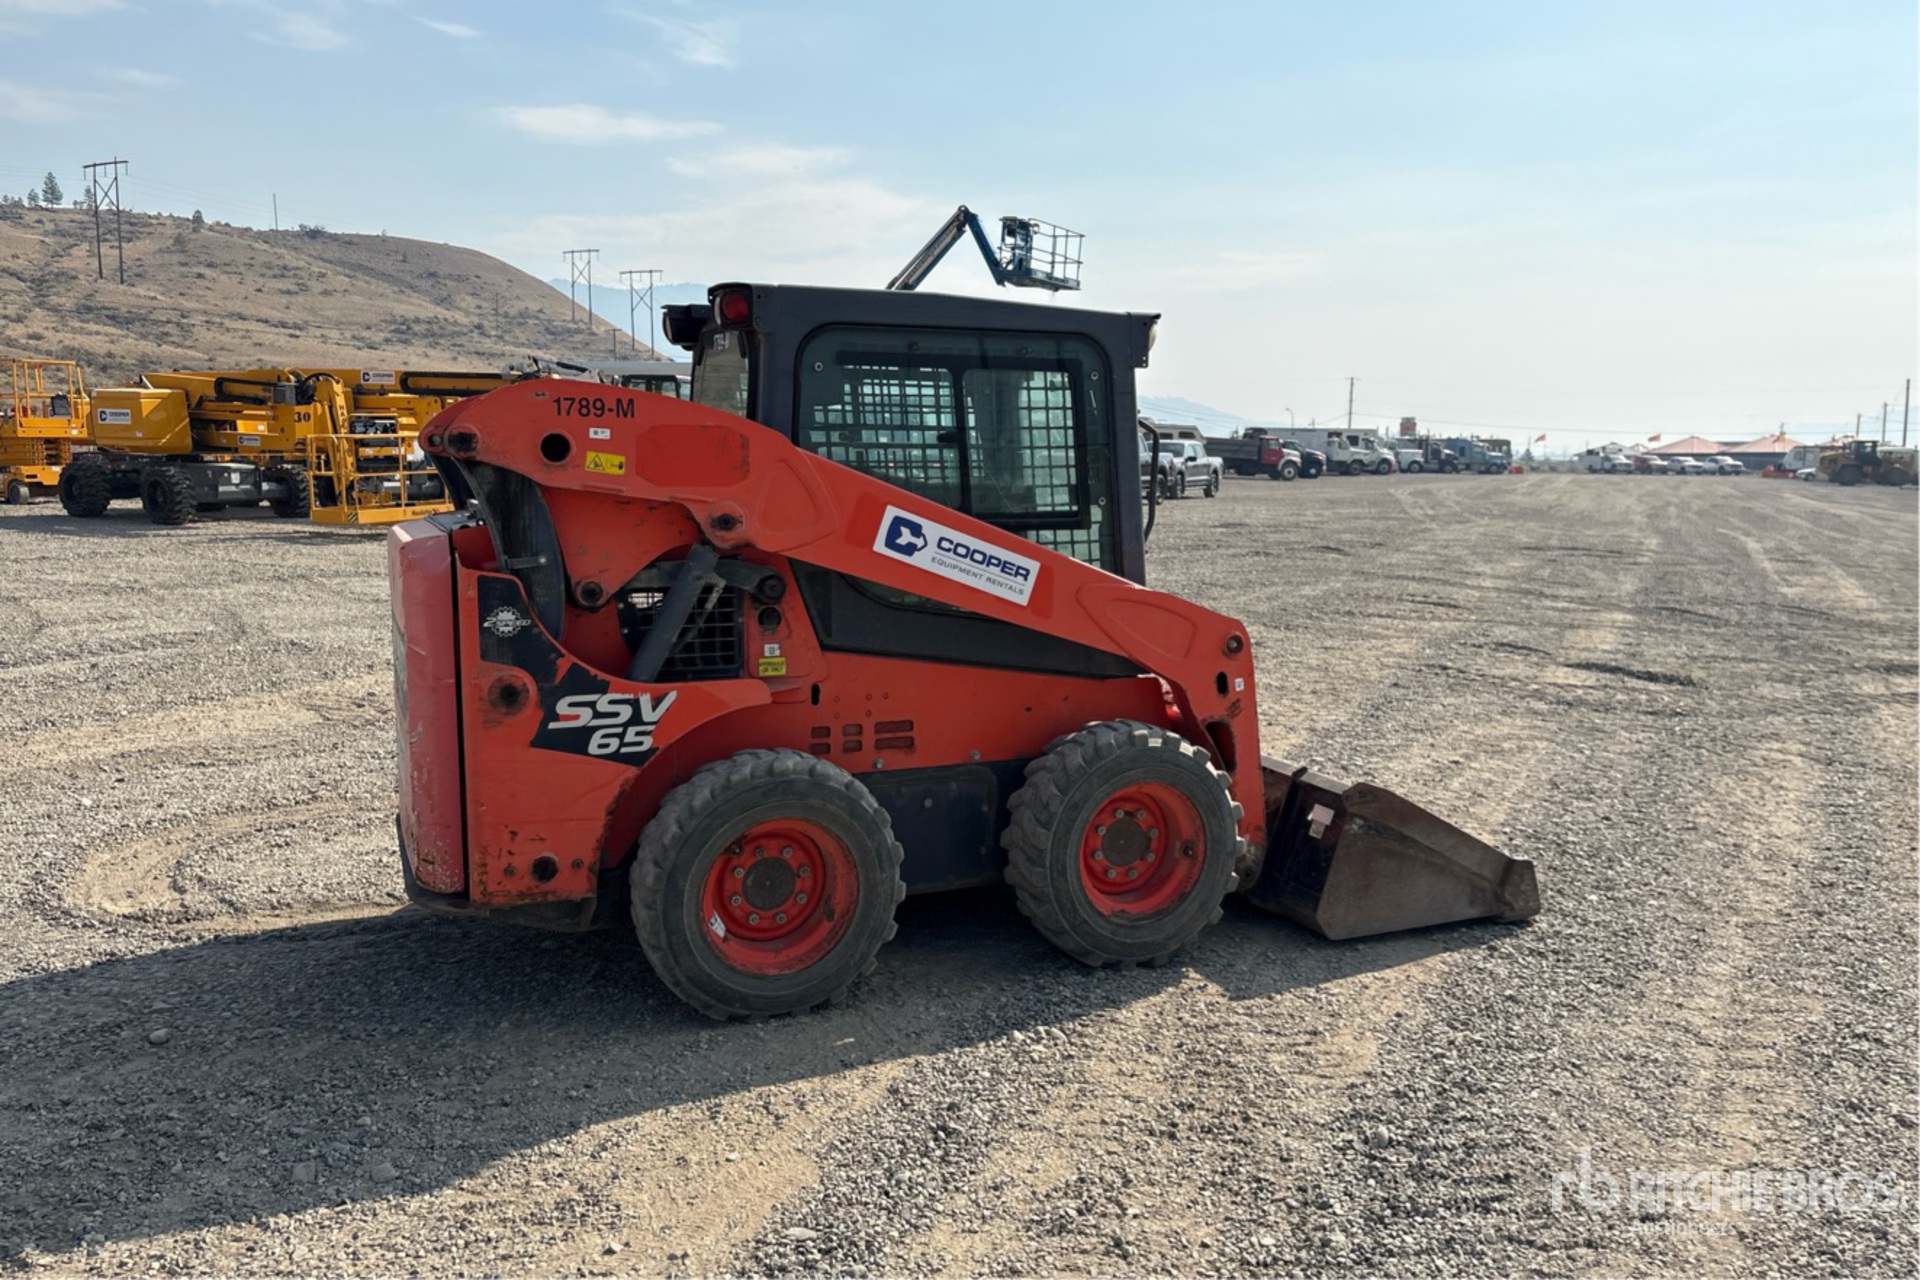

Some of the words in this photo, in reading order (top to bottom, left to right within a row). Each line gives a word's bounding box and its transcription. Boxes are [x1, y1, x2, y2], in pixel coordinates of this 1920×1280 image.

[294, 411, 311, 423] 30
[553, 397, 635, 418] 1789-M
[931, 556, 984, 581] EQUIPMENT
[985, 576, 1024, 596] RENTALS
[936, 536, 1031, 582] COOPER
[547, 690, 678, 729] SSV
[587, 725, 655, 755] 65
